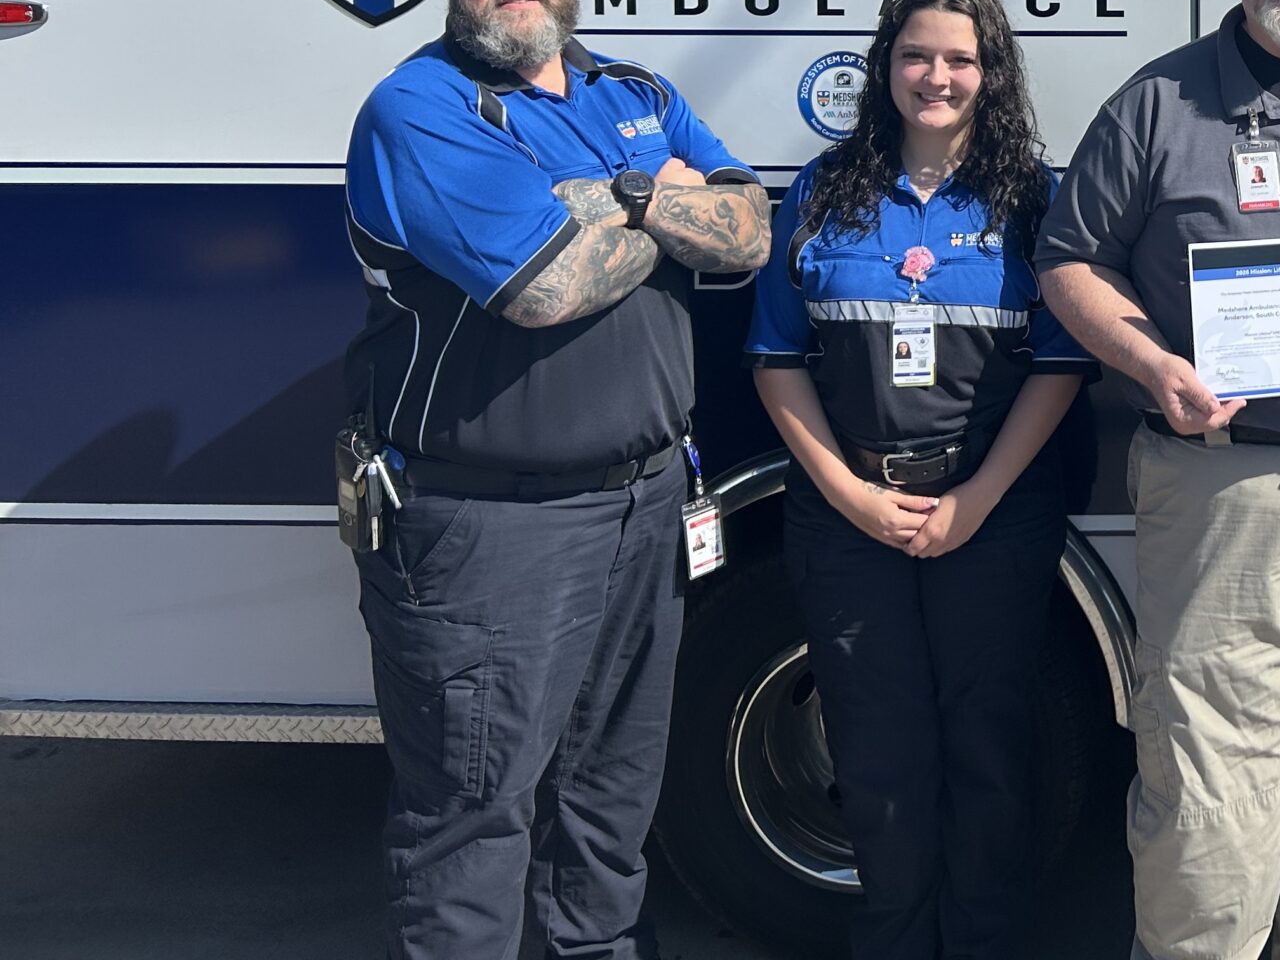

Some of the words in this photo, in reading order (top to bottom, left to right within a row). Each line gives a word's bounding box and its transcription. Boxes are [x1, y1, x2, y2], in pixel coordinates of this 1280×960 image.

[800, 77, 813, 99] 2022
[808, 55, 841, 78] SYSTEM
[842, 54, 857, 63] OF
[832, 92, 862, 102] MEDSHO
